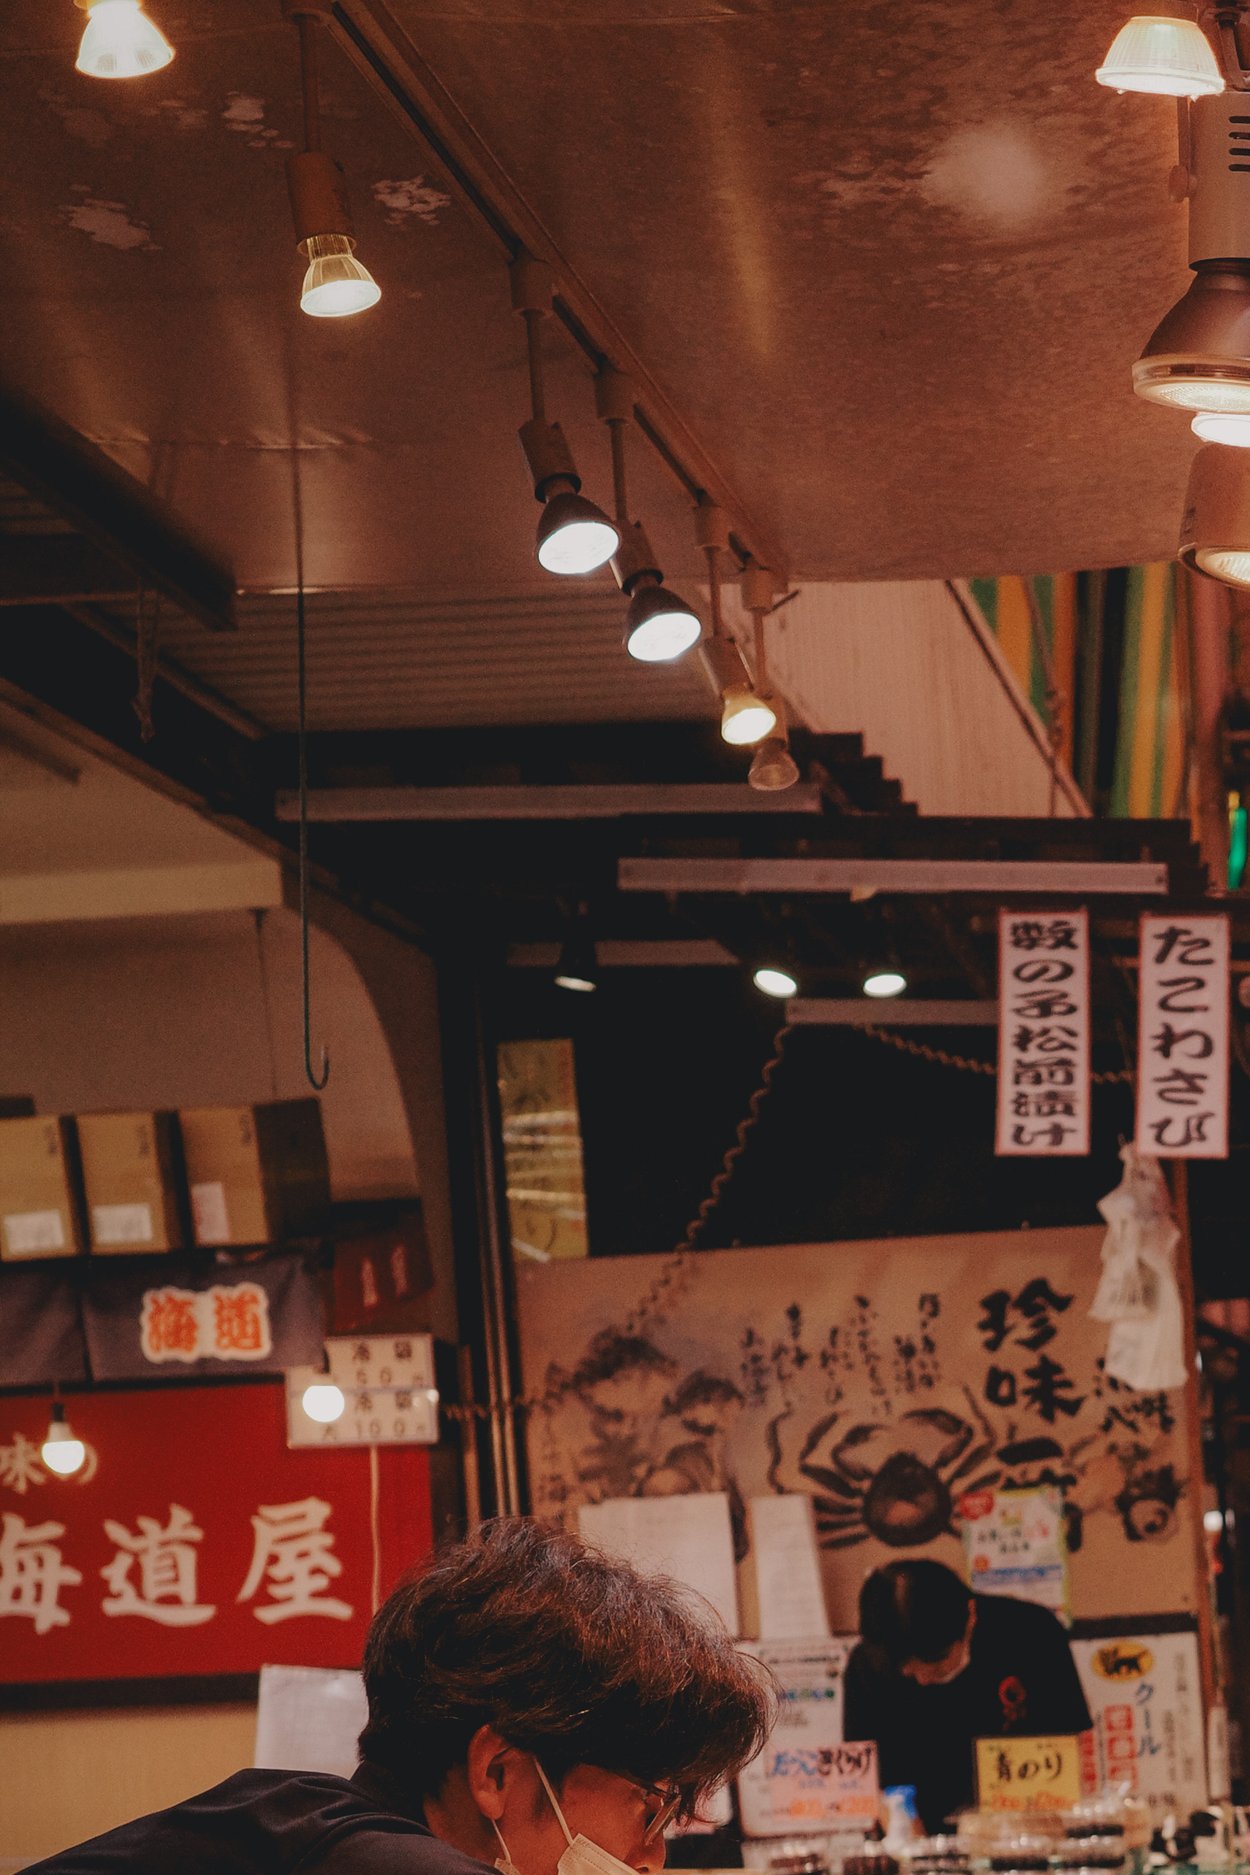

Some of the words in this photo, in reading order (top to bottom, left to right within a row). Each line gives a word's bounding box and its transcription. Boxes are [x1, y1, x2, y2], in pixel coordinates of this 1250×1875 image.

[1009, 920, 1080, 1149] 数の子松前漬け
[1149, 925, 1217, 1148] たこわさび
[976, 1276, 1085, 1423] 珍味
[997, 1751, 1063, 1784] 青のり
[1135, 1681, 1161, 1758] クール
